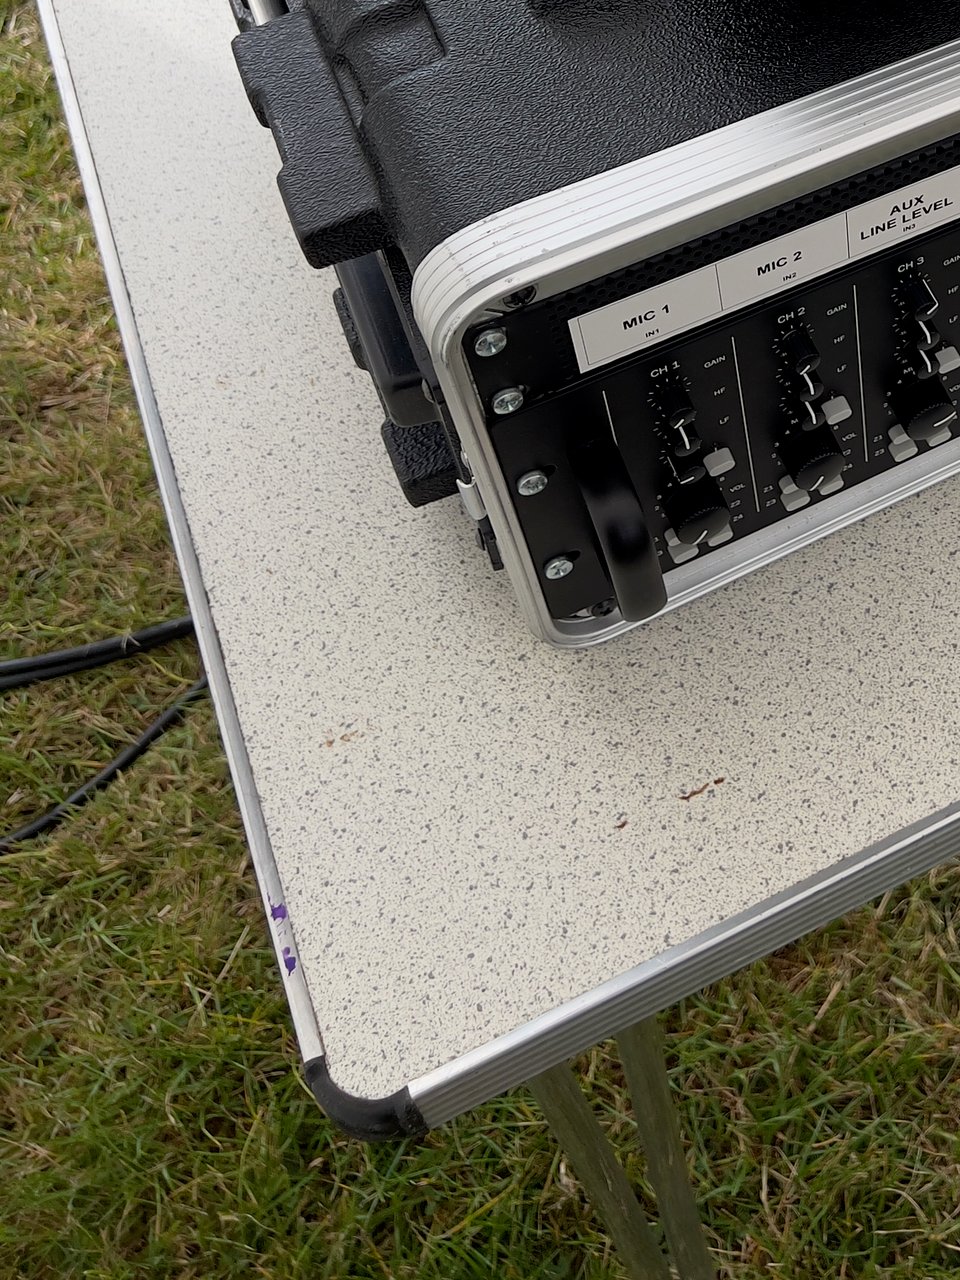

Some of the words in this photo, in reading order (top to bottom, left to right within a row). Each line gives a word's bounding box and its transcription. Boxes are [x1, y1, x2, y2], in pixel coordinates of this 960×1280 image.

[889, 194, 925, 216] AUX
[860, 221, 897, 241] LINE
[902, 197, 954, 224] LEVEL
[902, 223, 916, 233] IN3
[757, 258, 788, 276] MIC
[793, 251, 803, 261] 2
[897, 261, 915, 273] CH
[917, 256, 925, 266] 3
[782, 272, 797, 282] IN2
[948, 285, 959, 294] HF
[826, 303, 848, 316] GAIN
[622, 310, 656, 330] MIC
[661, 304, 671, 314] 1
[777, 312, 795, 324] CH
[797, 307, 806, 316] 2
[948, 314, 959, 324] LF
[645, 328, 660, 338] IN1
[833, 334, 846, 344] HF
[704, 355, 726, 369] GAIN
[650, 365, 668, 378] CH
[672, 361, 681, 370] 1
[836, 364, 847, 373] LF
[713, 386, 726, 396] HF
[719, 416, 730, 425] LF
[873, 434, 883, 443] Z1
[874, 448, 885, 457] Z3
[729, 482, 746, 493] VOL
[765, 498, 777, 508] Z3
